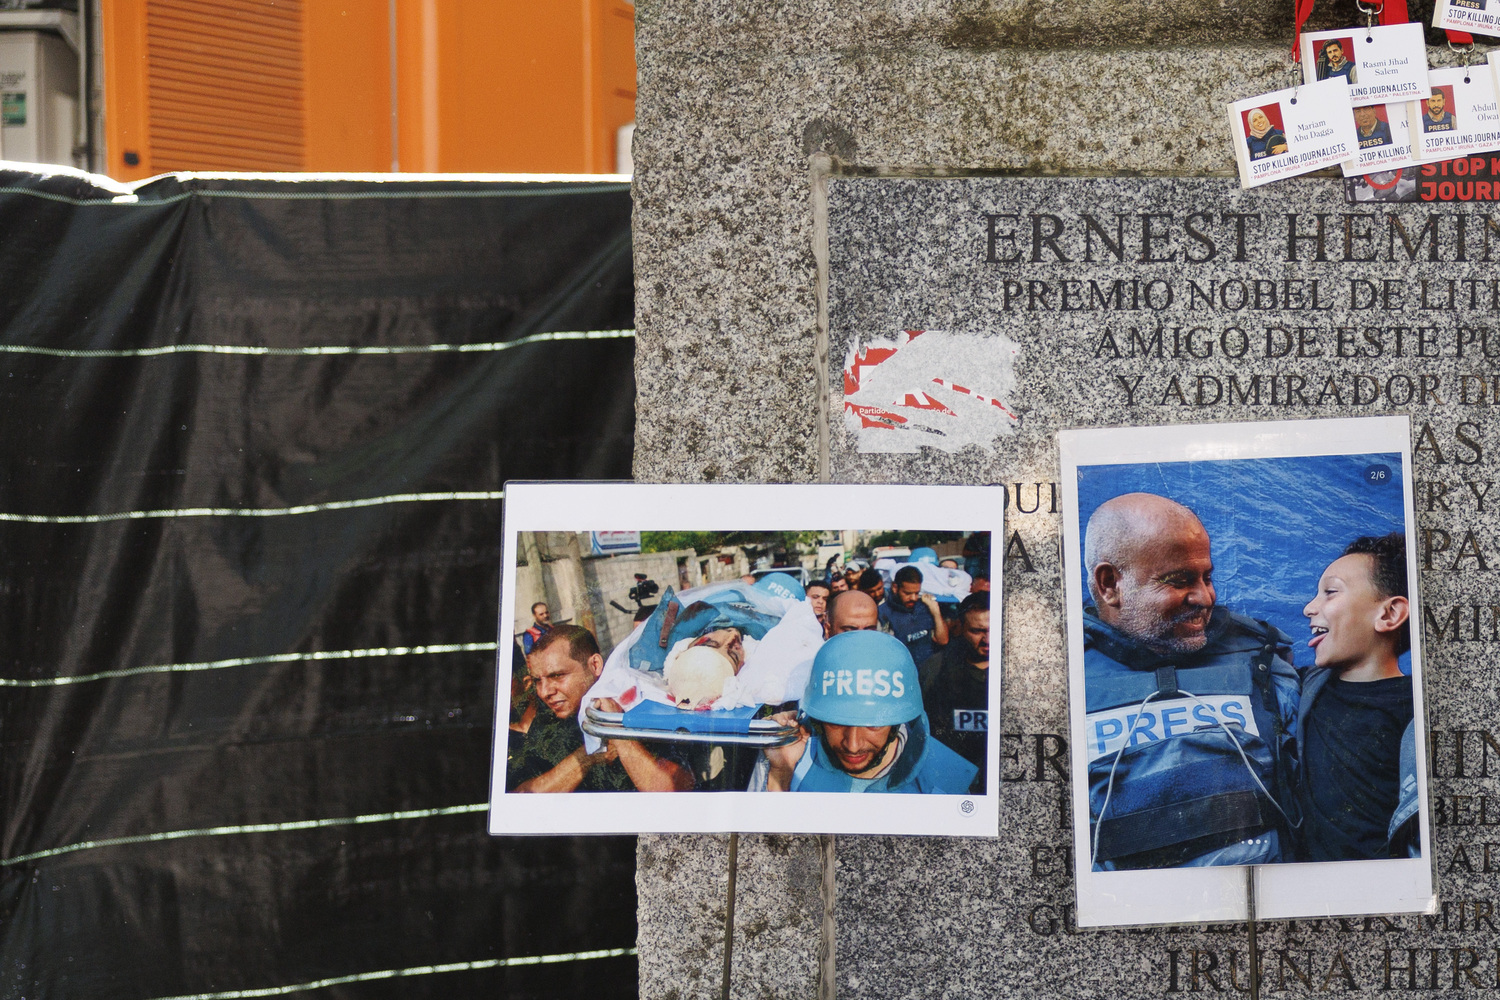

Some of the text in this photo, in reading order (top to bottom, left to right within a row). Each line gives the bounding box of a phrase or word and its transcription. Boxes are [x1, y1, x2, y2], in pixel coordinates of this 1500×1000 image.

[1448, 9, 1465, 19] STOP
[1468, 13, 1494, 24] KILLING
[1363, 60, 1386, 69] Rasmi
[1375, 68, 1398, 76] Salem
[1472, 104, 1497, 112] Abdull
[1294, 128, 1334, 143] Abu Dagga
[1297, 120, 1326, 131] Mariam
[1253, 143, 1346, 174] STOP KILLING JOURNALISTS
[1421, 157, 1485, 176] STOP
[982, 213, 1260, 262] ERNEST
[1002, 279, 1174, 311] PREMIO
[1186, 279, 1334, 311] NOBEL
[1350, 279, 1402, 311] DE
[1095, 326, 1249, 359] AMIGO
[1264, 327, 1325, 358] DE
[1336, 326, 1441, 358] ESTE
[1116, 375, 1145, 406] Y
[1160, 375, 1445, 406] ADMIRADOR
[1371, 471, 1385, 479] 2/6
[1466, 481, 1495, 512] Y
[823, 669, 904, 698] PRESS
[1095, 699, 1247, 755] PRESS
[1166, 938, 1359, 992] IRUÑA
